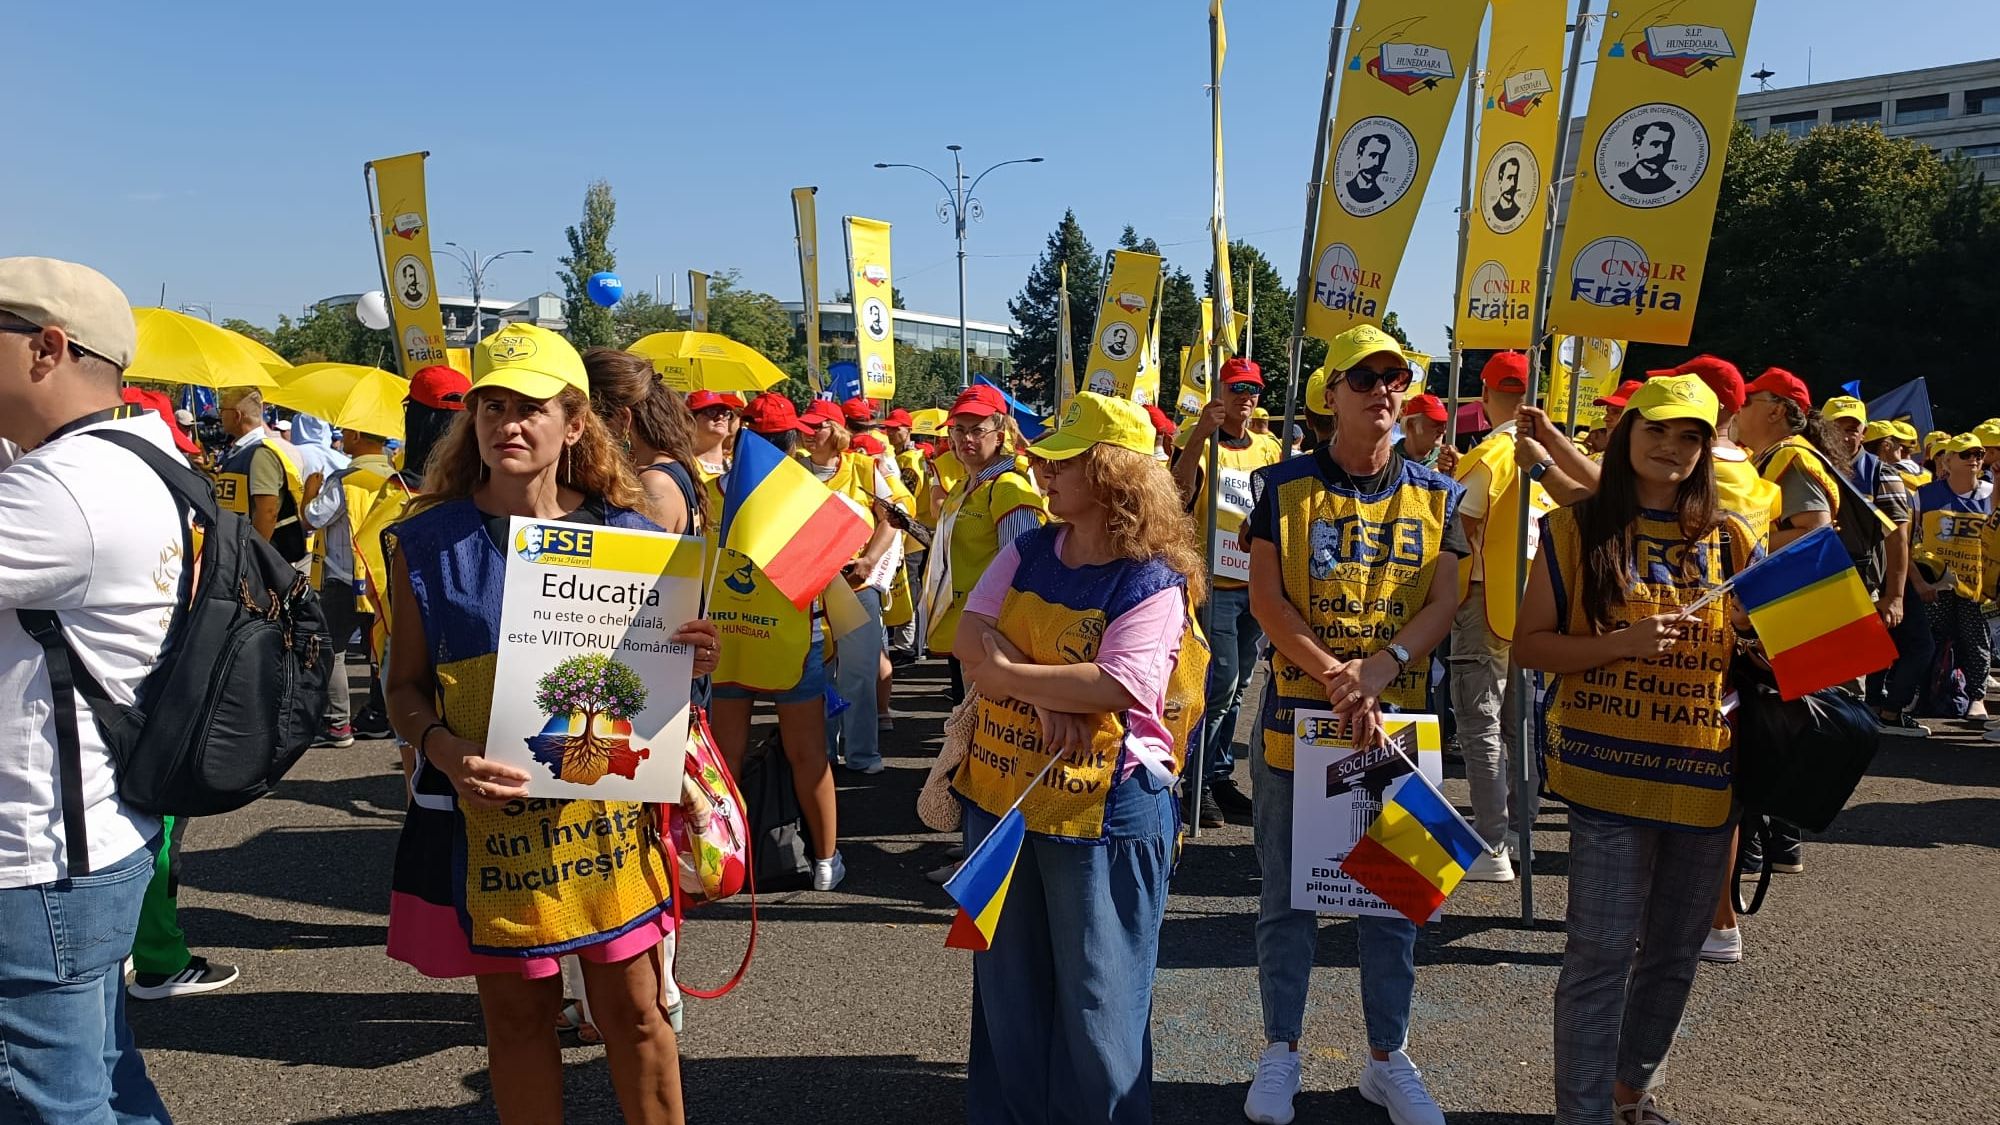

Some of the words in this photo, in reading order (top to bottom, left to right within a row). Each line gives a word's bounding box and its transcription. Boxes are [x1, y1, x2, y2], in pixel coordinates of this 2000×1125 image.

[1666, 39, 1718, 49] HUNEDOARA
[1396, 57, 1441, 69] HUNEDOARA
[1649, 107, 1699, 131] INDEPENDENTE
[1619, 192, 1641, 205] SPIRU
[1641, 195, 1667, 205] HARET
[1330, 264, 1382, 290] CNSLR
[1601, 258, 1687, 282] CNSLR
[1483, 279, 1530, 294] CNSLR
[1570, 277, 1682, 316] Frăția
[1313, 281, 1377, 320] Frăția
[1467, 298, 1529, 327] Frăția
[407, 347, 443, 362] Frăția
[215, 479, 236, 499] SE
[543, 529, 592, 553] FSE
[1340, 520, 1418, 562] FSE
[542, 573, 660, 612] Educația
[533, 609, 551, 621] nu
[555, 611, 584, 623] este
[587, 613, 596, 624] o
[599, 612, 667, 632] cheltuială,
[508, 633, 537, 645] este
[541, 629, 619, 651] VIITORUL
[622, 638, 688, 655] României!
[1583, 669, 1618, 688] din
[1338, 733, 1407, 777] SOCIETATE
[1590, 745, 1662, 769] SUNTEM
[485, 832, 532, 858] din
[1306, 881, 1351, 894] pilonul
[1317, 894, 1343, 906] Nu-l
